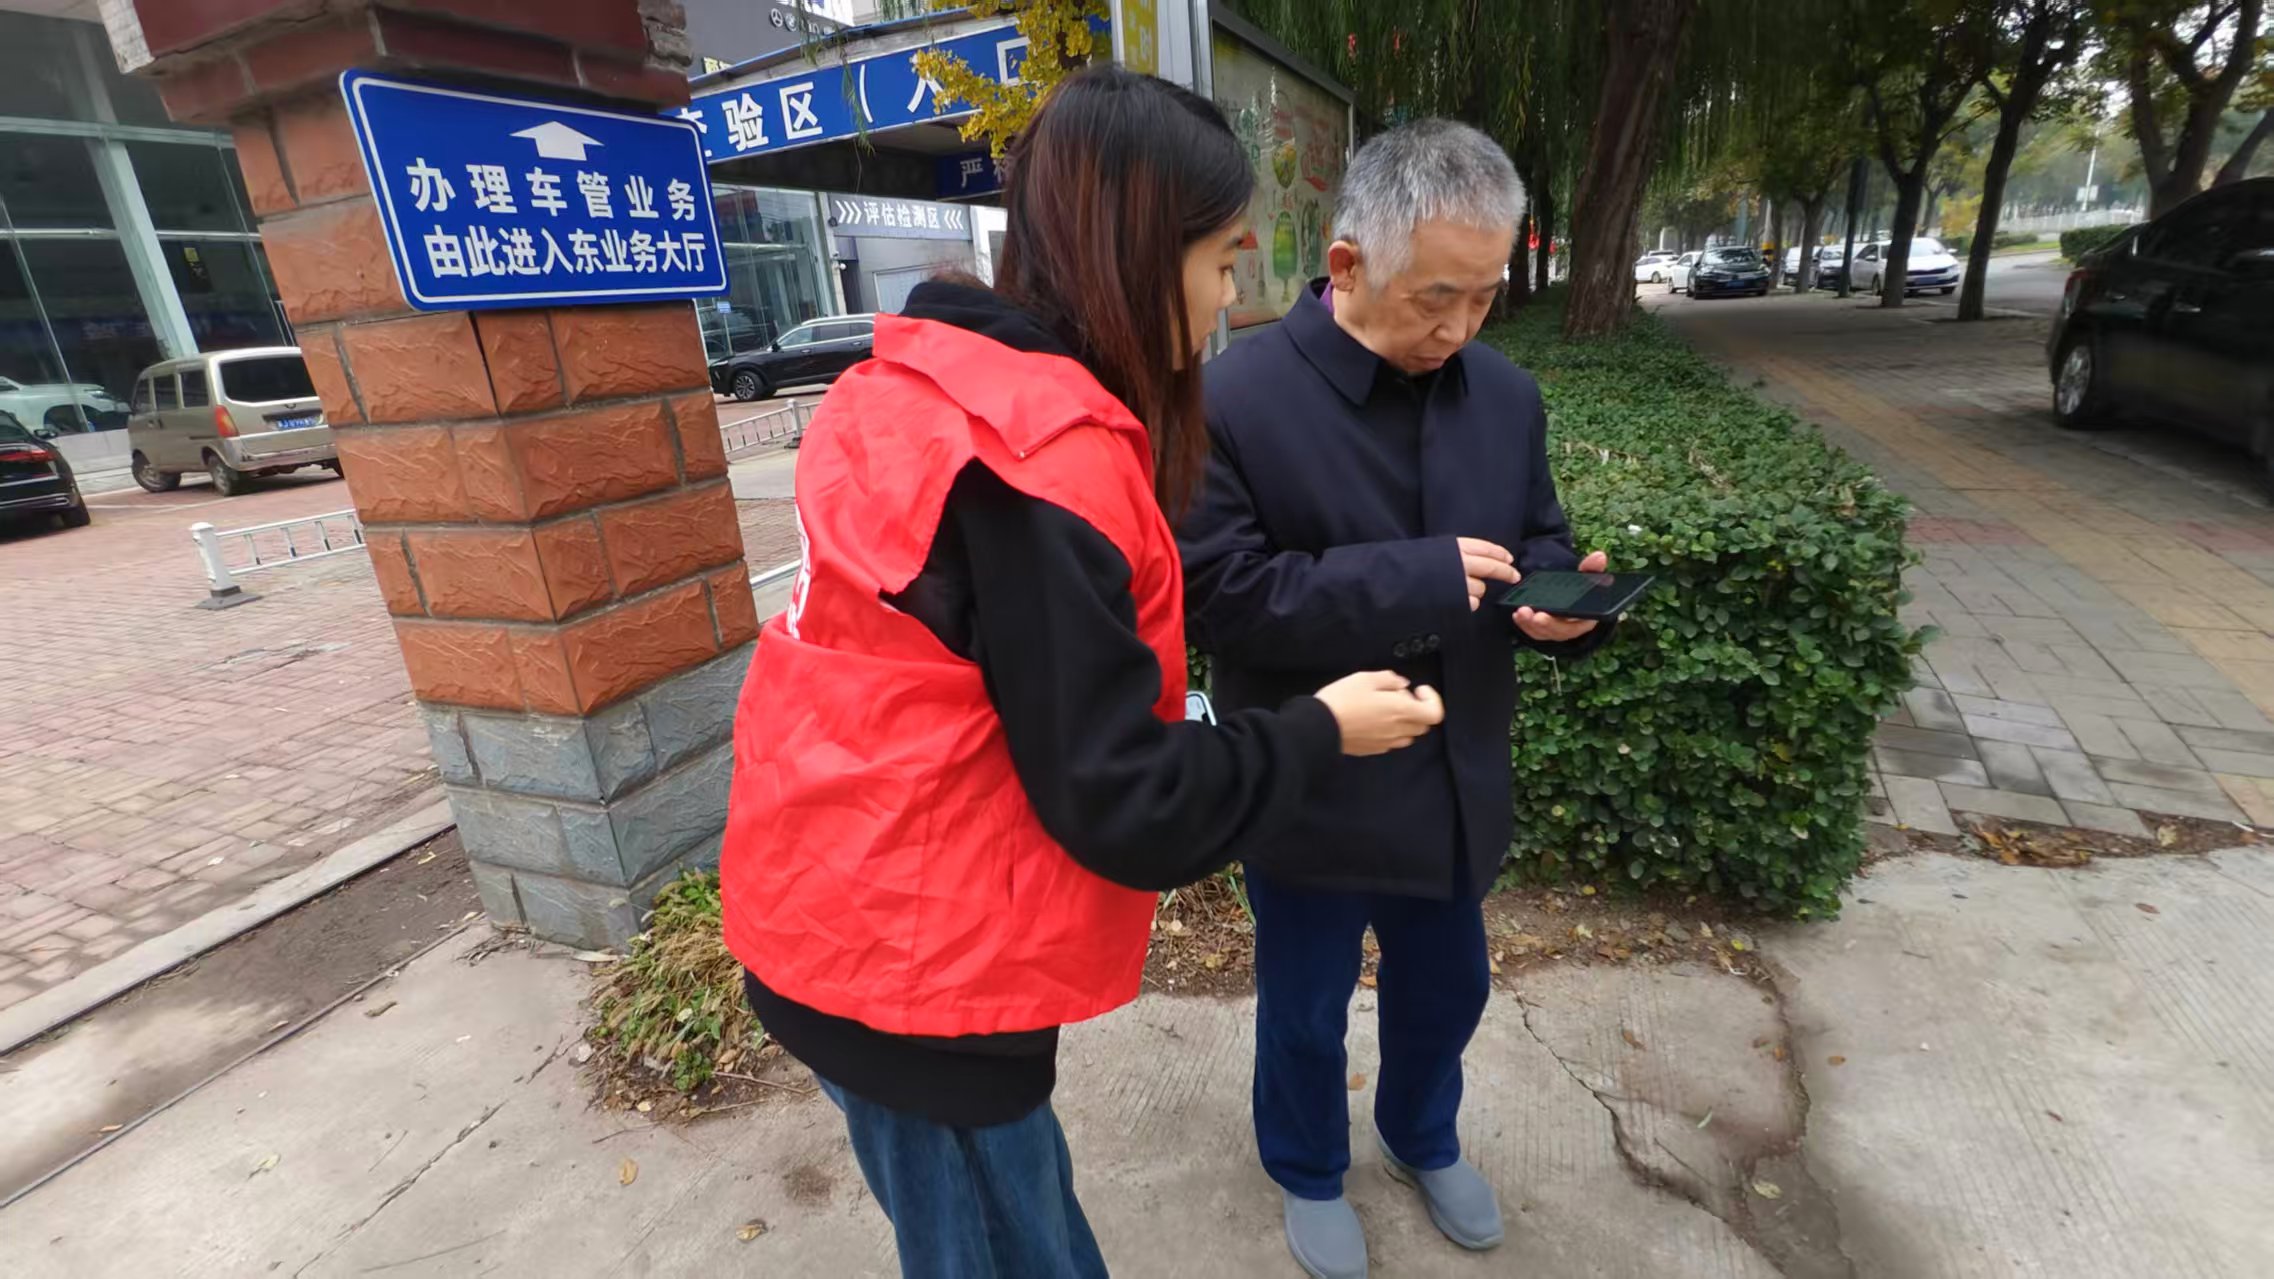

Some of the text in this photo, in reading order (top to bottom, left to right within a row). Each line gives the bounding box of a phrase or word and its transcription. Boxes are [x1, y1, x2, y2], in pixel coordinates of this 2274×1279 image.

[405, 157, 696, 221] 办理车管业务
[863, 202, 940, 229] 评估检测区
[423, 225, 706, 278] 由此进入东业务大厅
